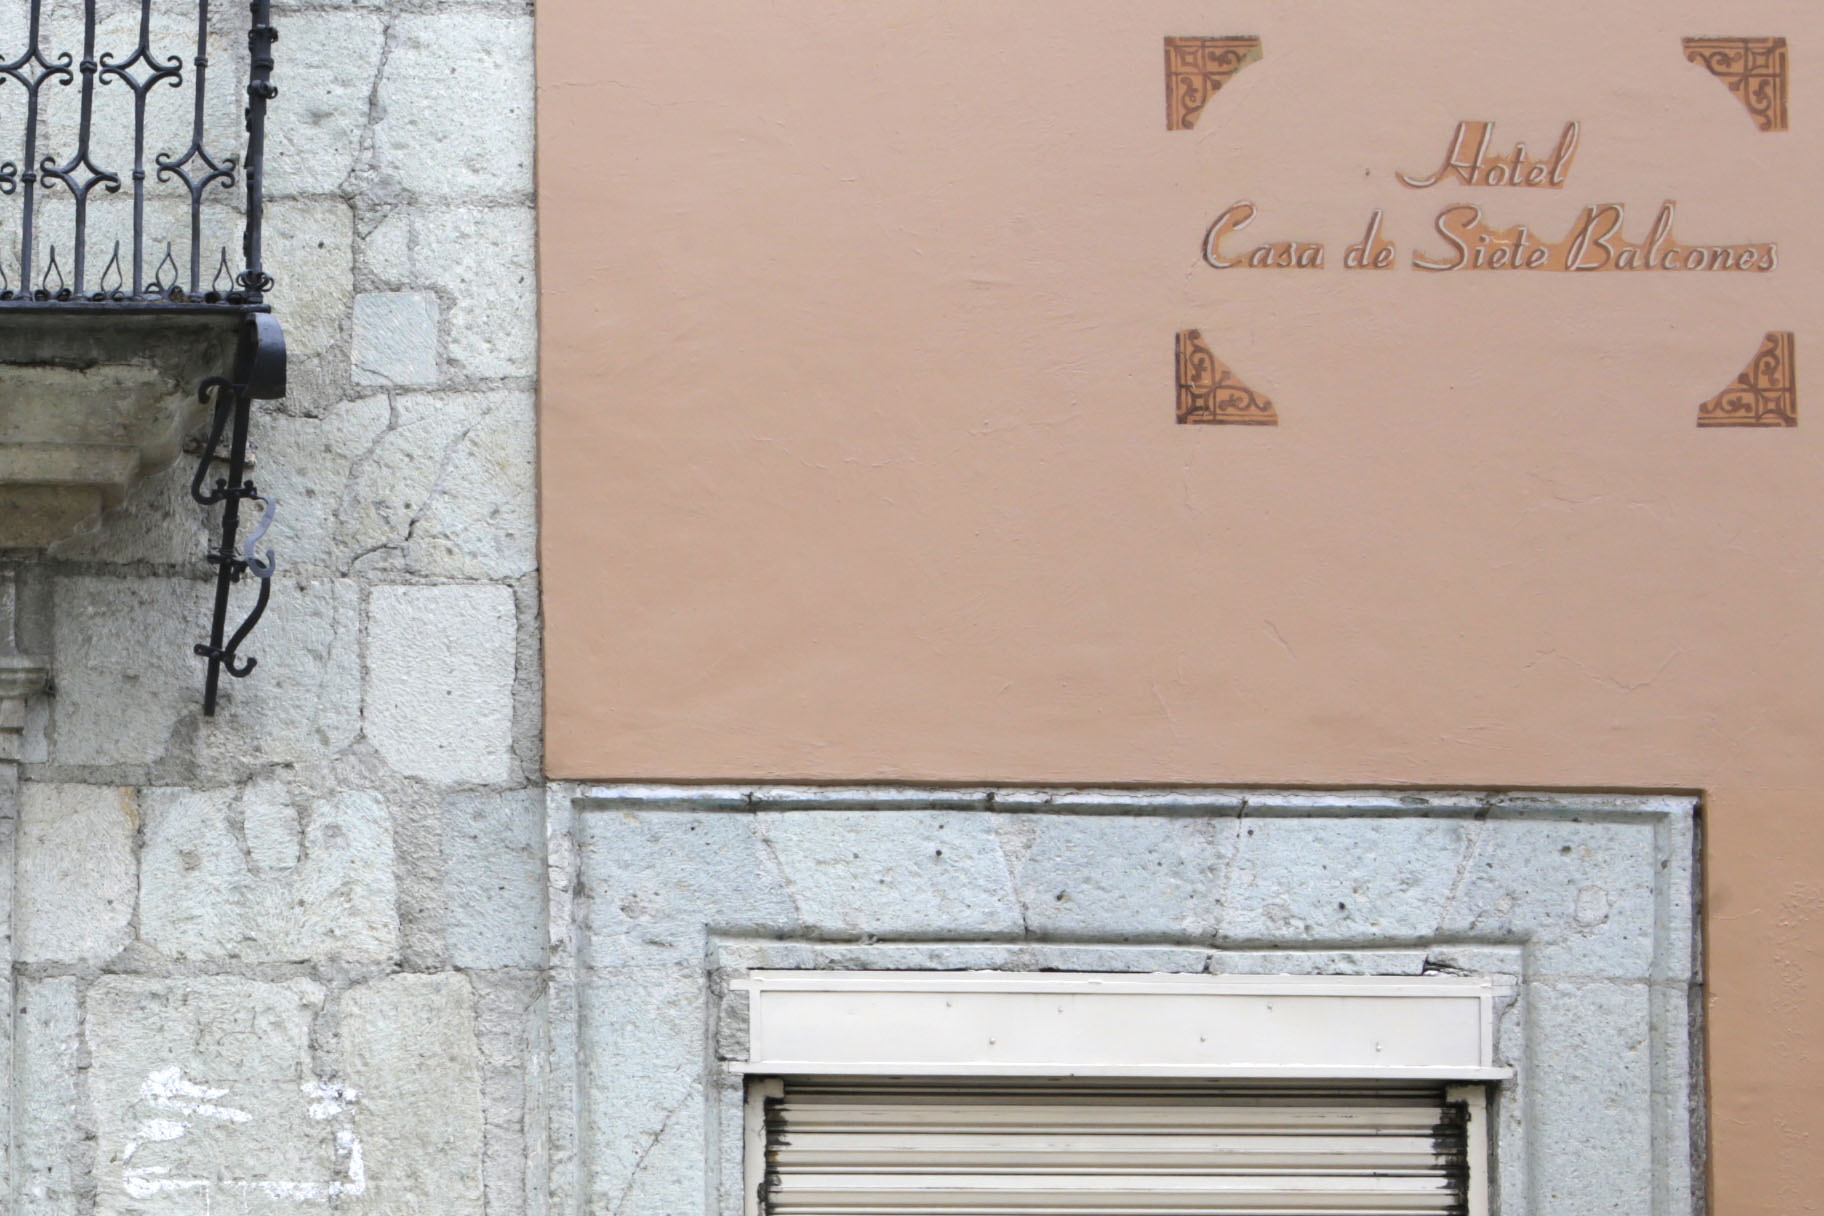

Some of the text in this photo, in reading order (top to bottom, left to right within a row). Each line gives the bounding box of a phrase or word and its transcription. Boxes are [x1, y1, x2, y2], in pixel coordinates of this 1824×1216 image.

[1395, 120, 1581, 188] Hotel
[1202, 200, 1777, 272] Casa de Siete Balcones
